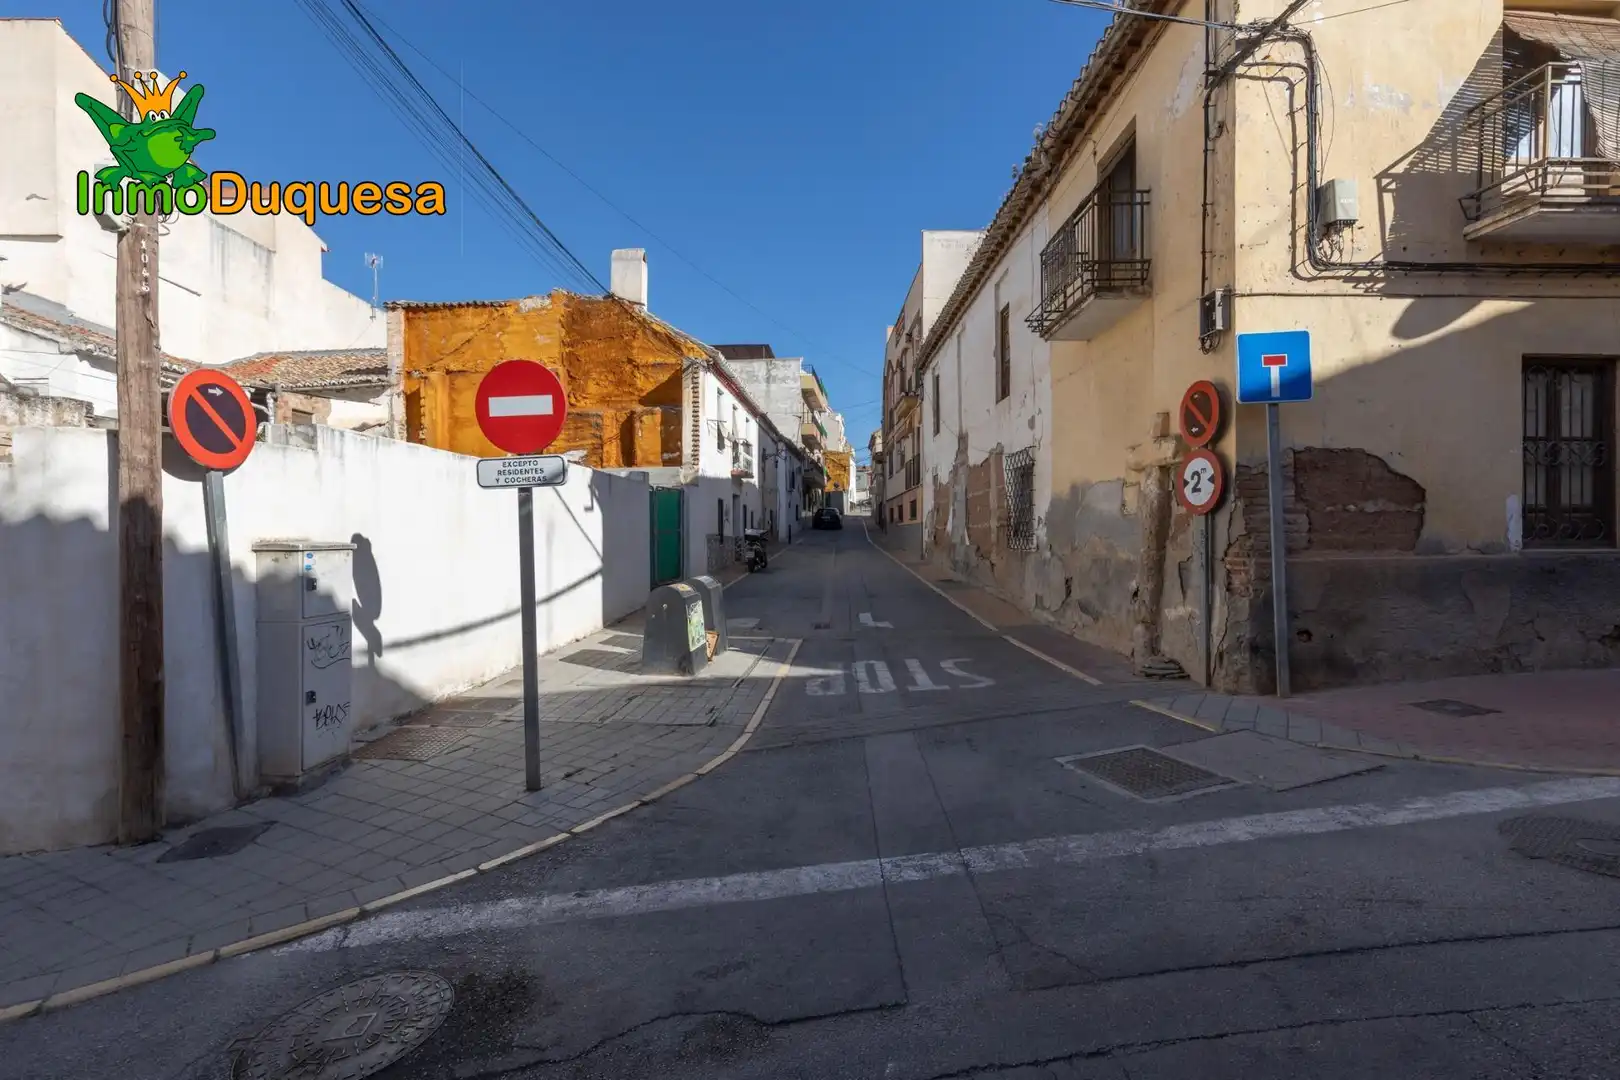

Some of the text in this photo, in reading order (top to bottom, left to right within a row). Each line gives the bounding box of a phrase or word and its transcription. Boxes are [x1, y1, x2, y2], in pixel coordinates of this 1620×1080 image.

[502, 460, 539, 468] EXCEPTO
[497, 468, 544, 476] RESIDENTES
[504, 476, 547, 484] COCHERAS
[805, 658, 996, 695] STOP
